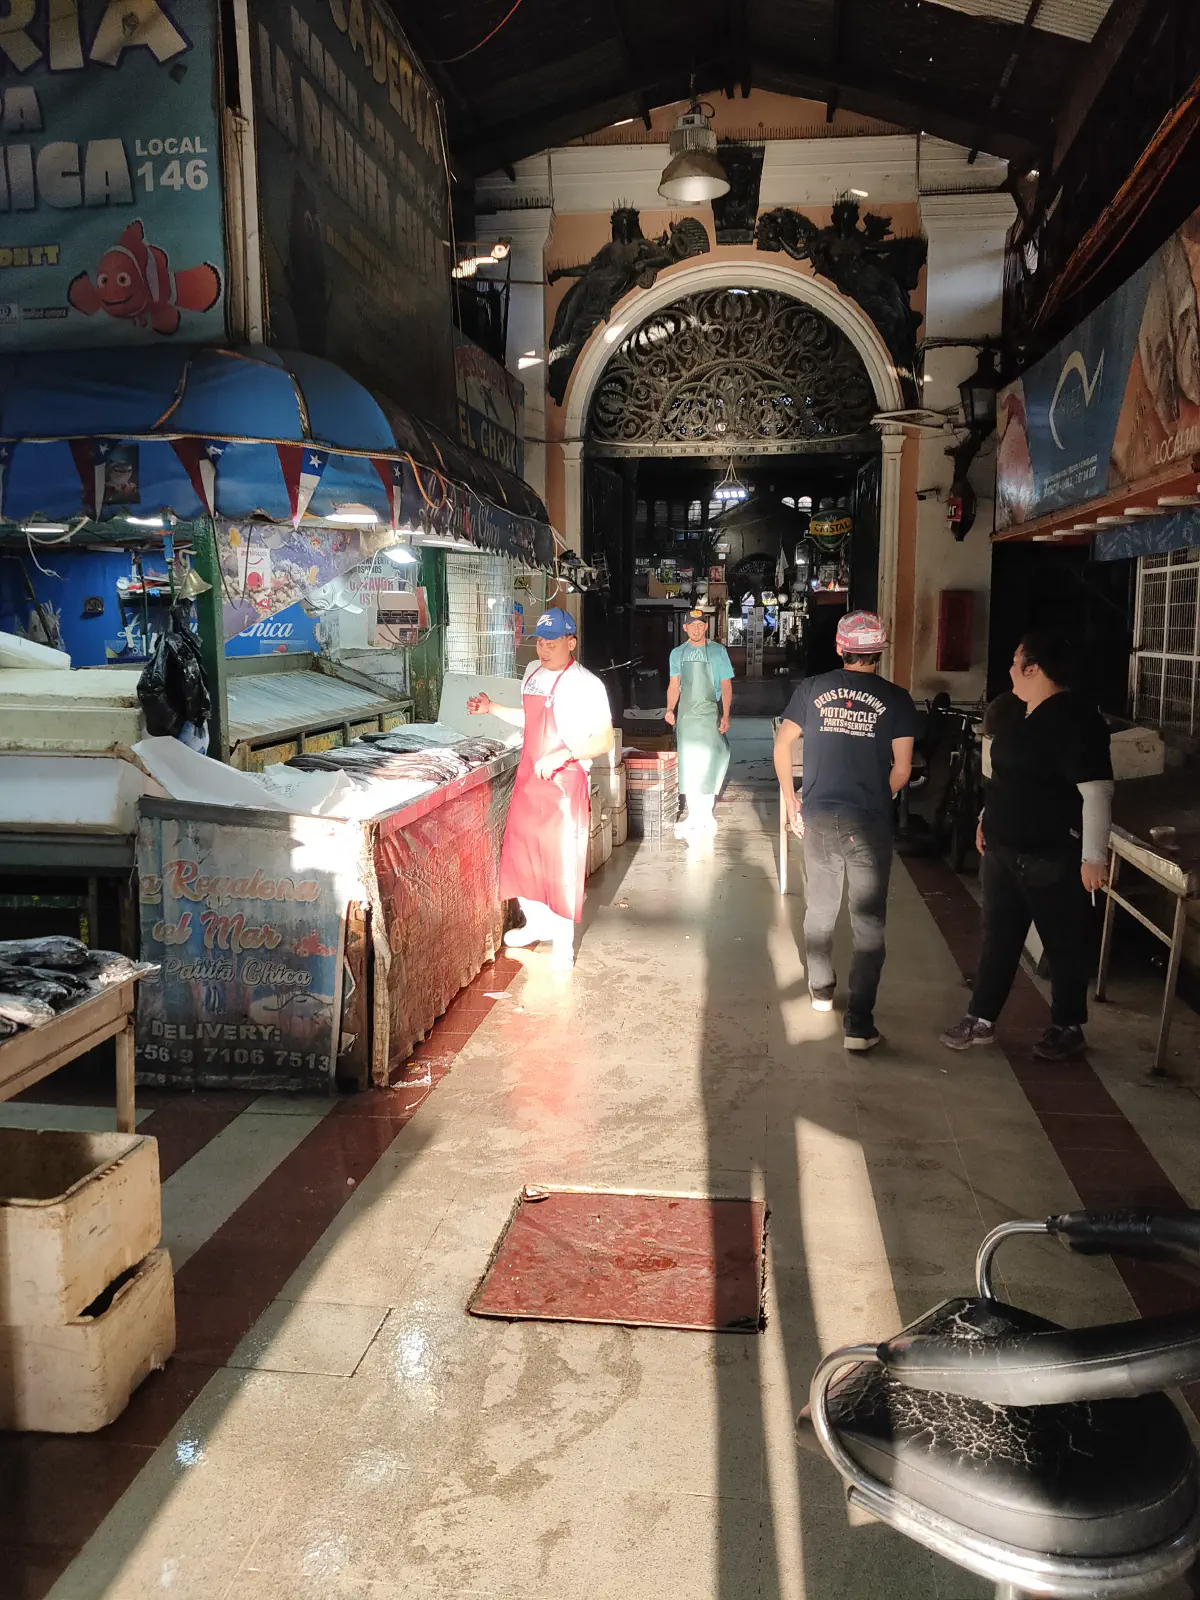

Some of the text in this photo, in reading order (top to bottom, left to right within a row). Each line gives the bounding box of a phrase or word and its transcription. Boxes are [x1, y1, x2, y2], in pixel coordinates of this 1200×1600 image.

[0, 85, 41, 132] A
[135, 137, 207, 156] LOCAL
[0, 138, 134, 210] ICA
[136, 159, 208, 192] 146
[458, 402, 518, 474] EL CHOLO
[1155, 431, 1185, 464] LOCAL
[814, 521, 850, 533] CRISTAL
[813, 687, 887, 716] DEUS EX MACHINA
[823, 717, 844, 727] PARTS
[847, 721, 874, 732] SERVICE
[162, 858, 321, 908] Regalona
[200, 909, 281, 953] Mar
[241, 957, 313, 986] Chica
[152, 1020, 281, 1042] DELIVERY:
[204, 1047, 264, 1065] 7106
[274, 1050, 330, 1073] 7513
